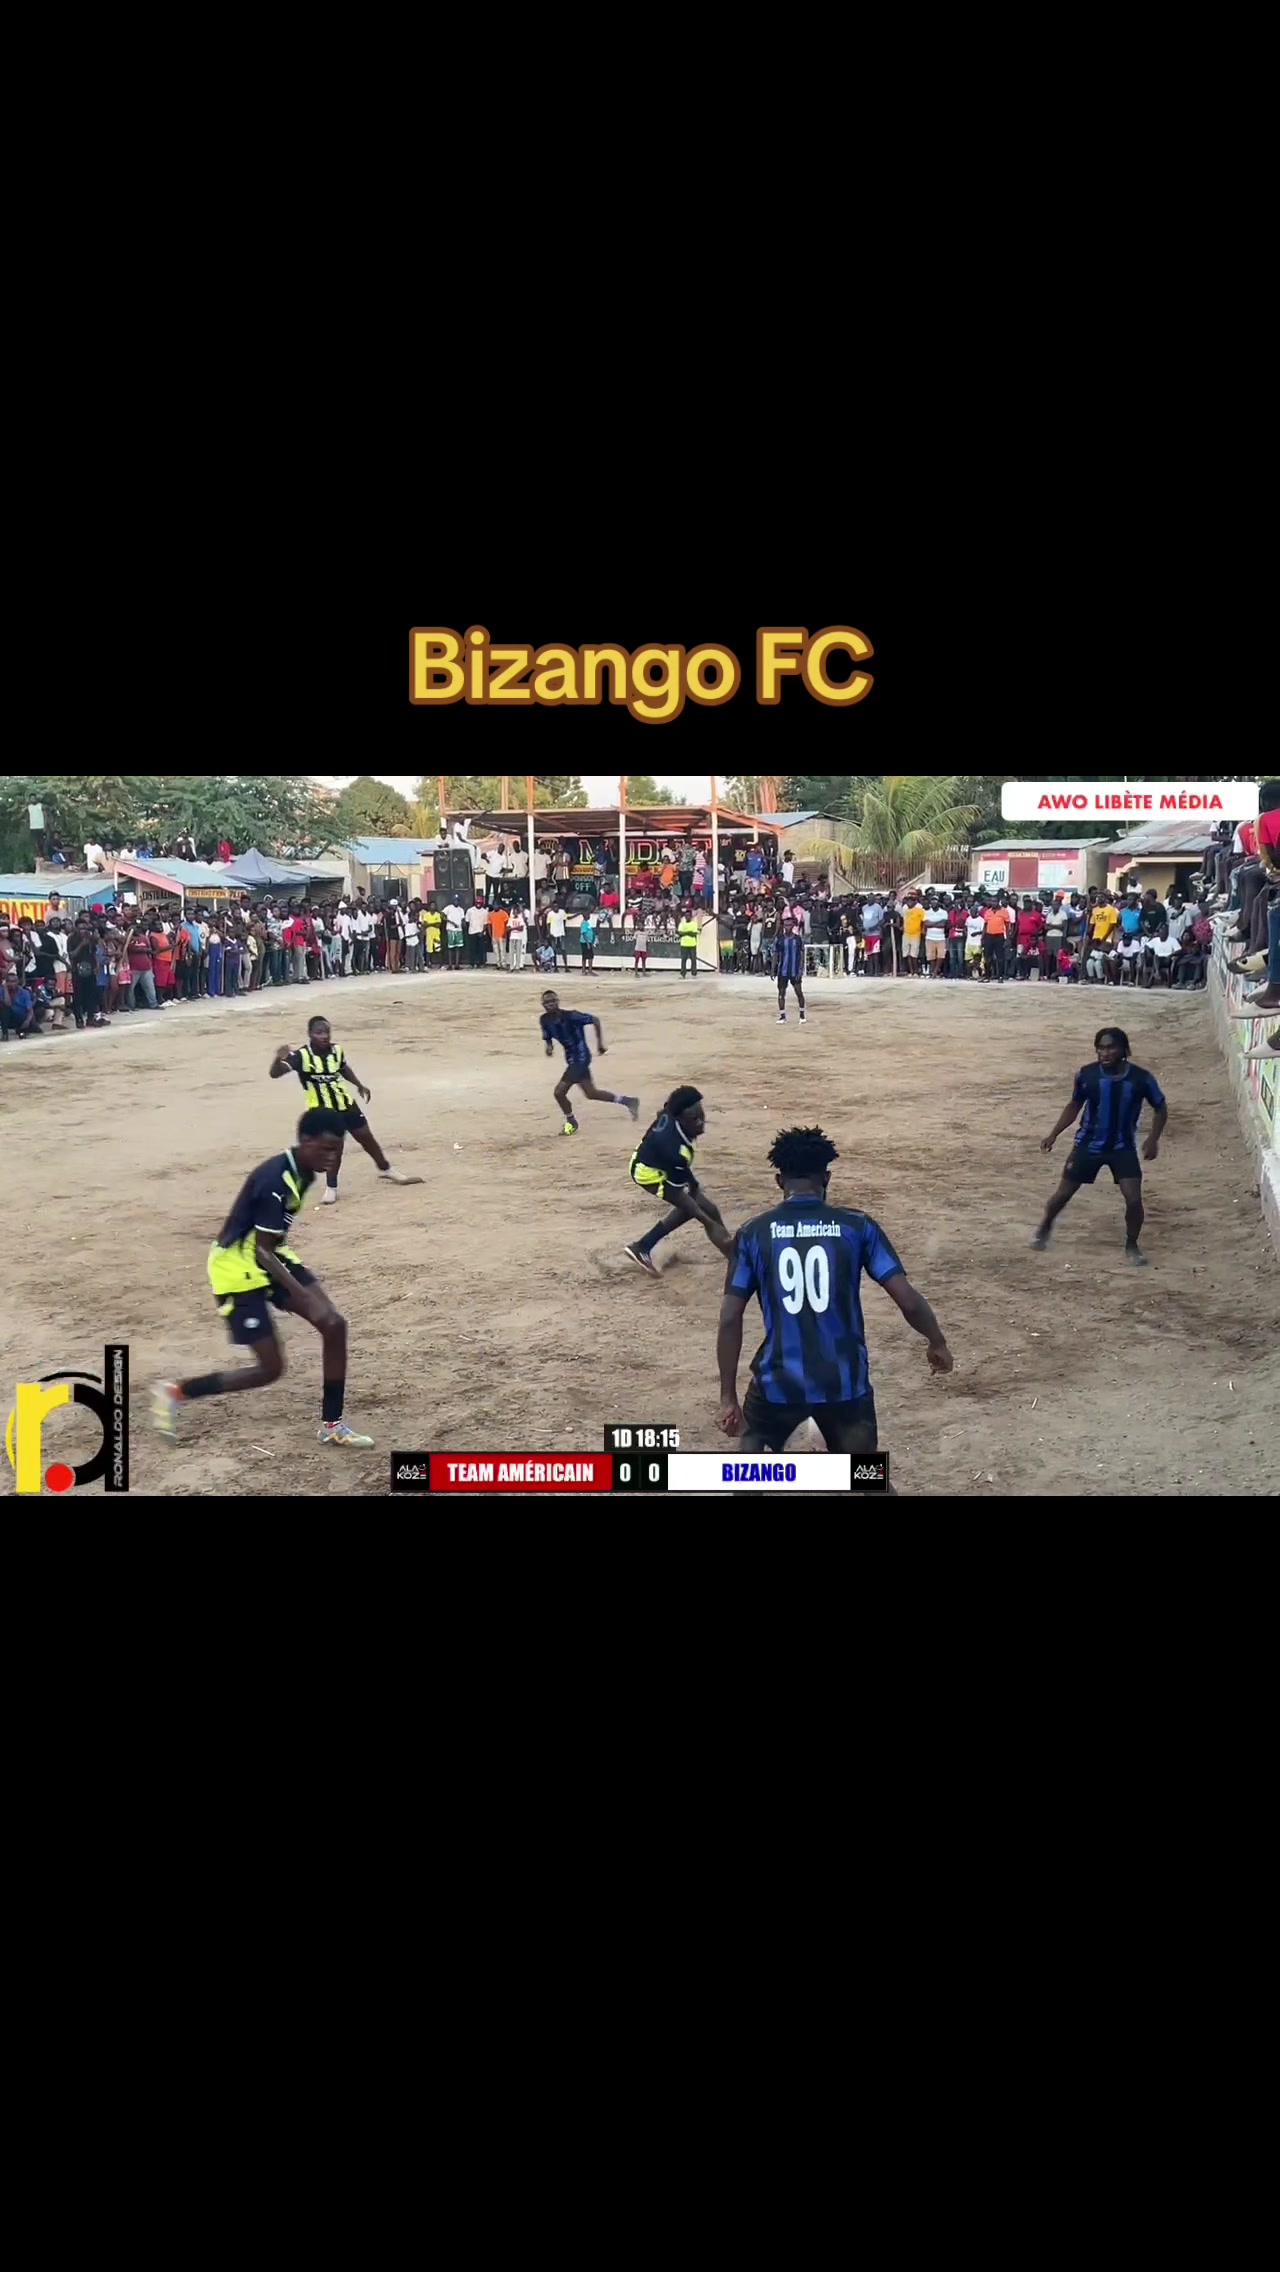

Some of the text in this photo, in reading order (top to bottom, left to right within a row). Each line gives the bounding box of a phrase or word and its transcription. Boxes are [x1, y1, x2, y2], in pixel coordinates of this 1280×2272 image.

[984, 870, 1005, 882] EAU
[770, 1220, 841, 1239] Team Americain
[778, 1245, 830, 1315] 90
